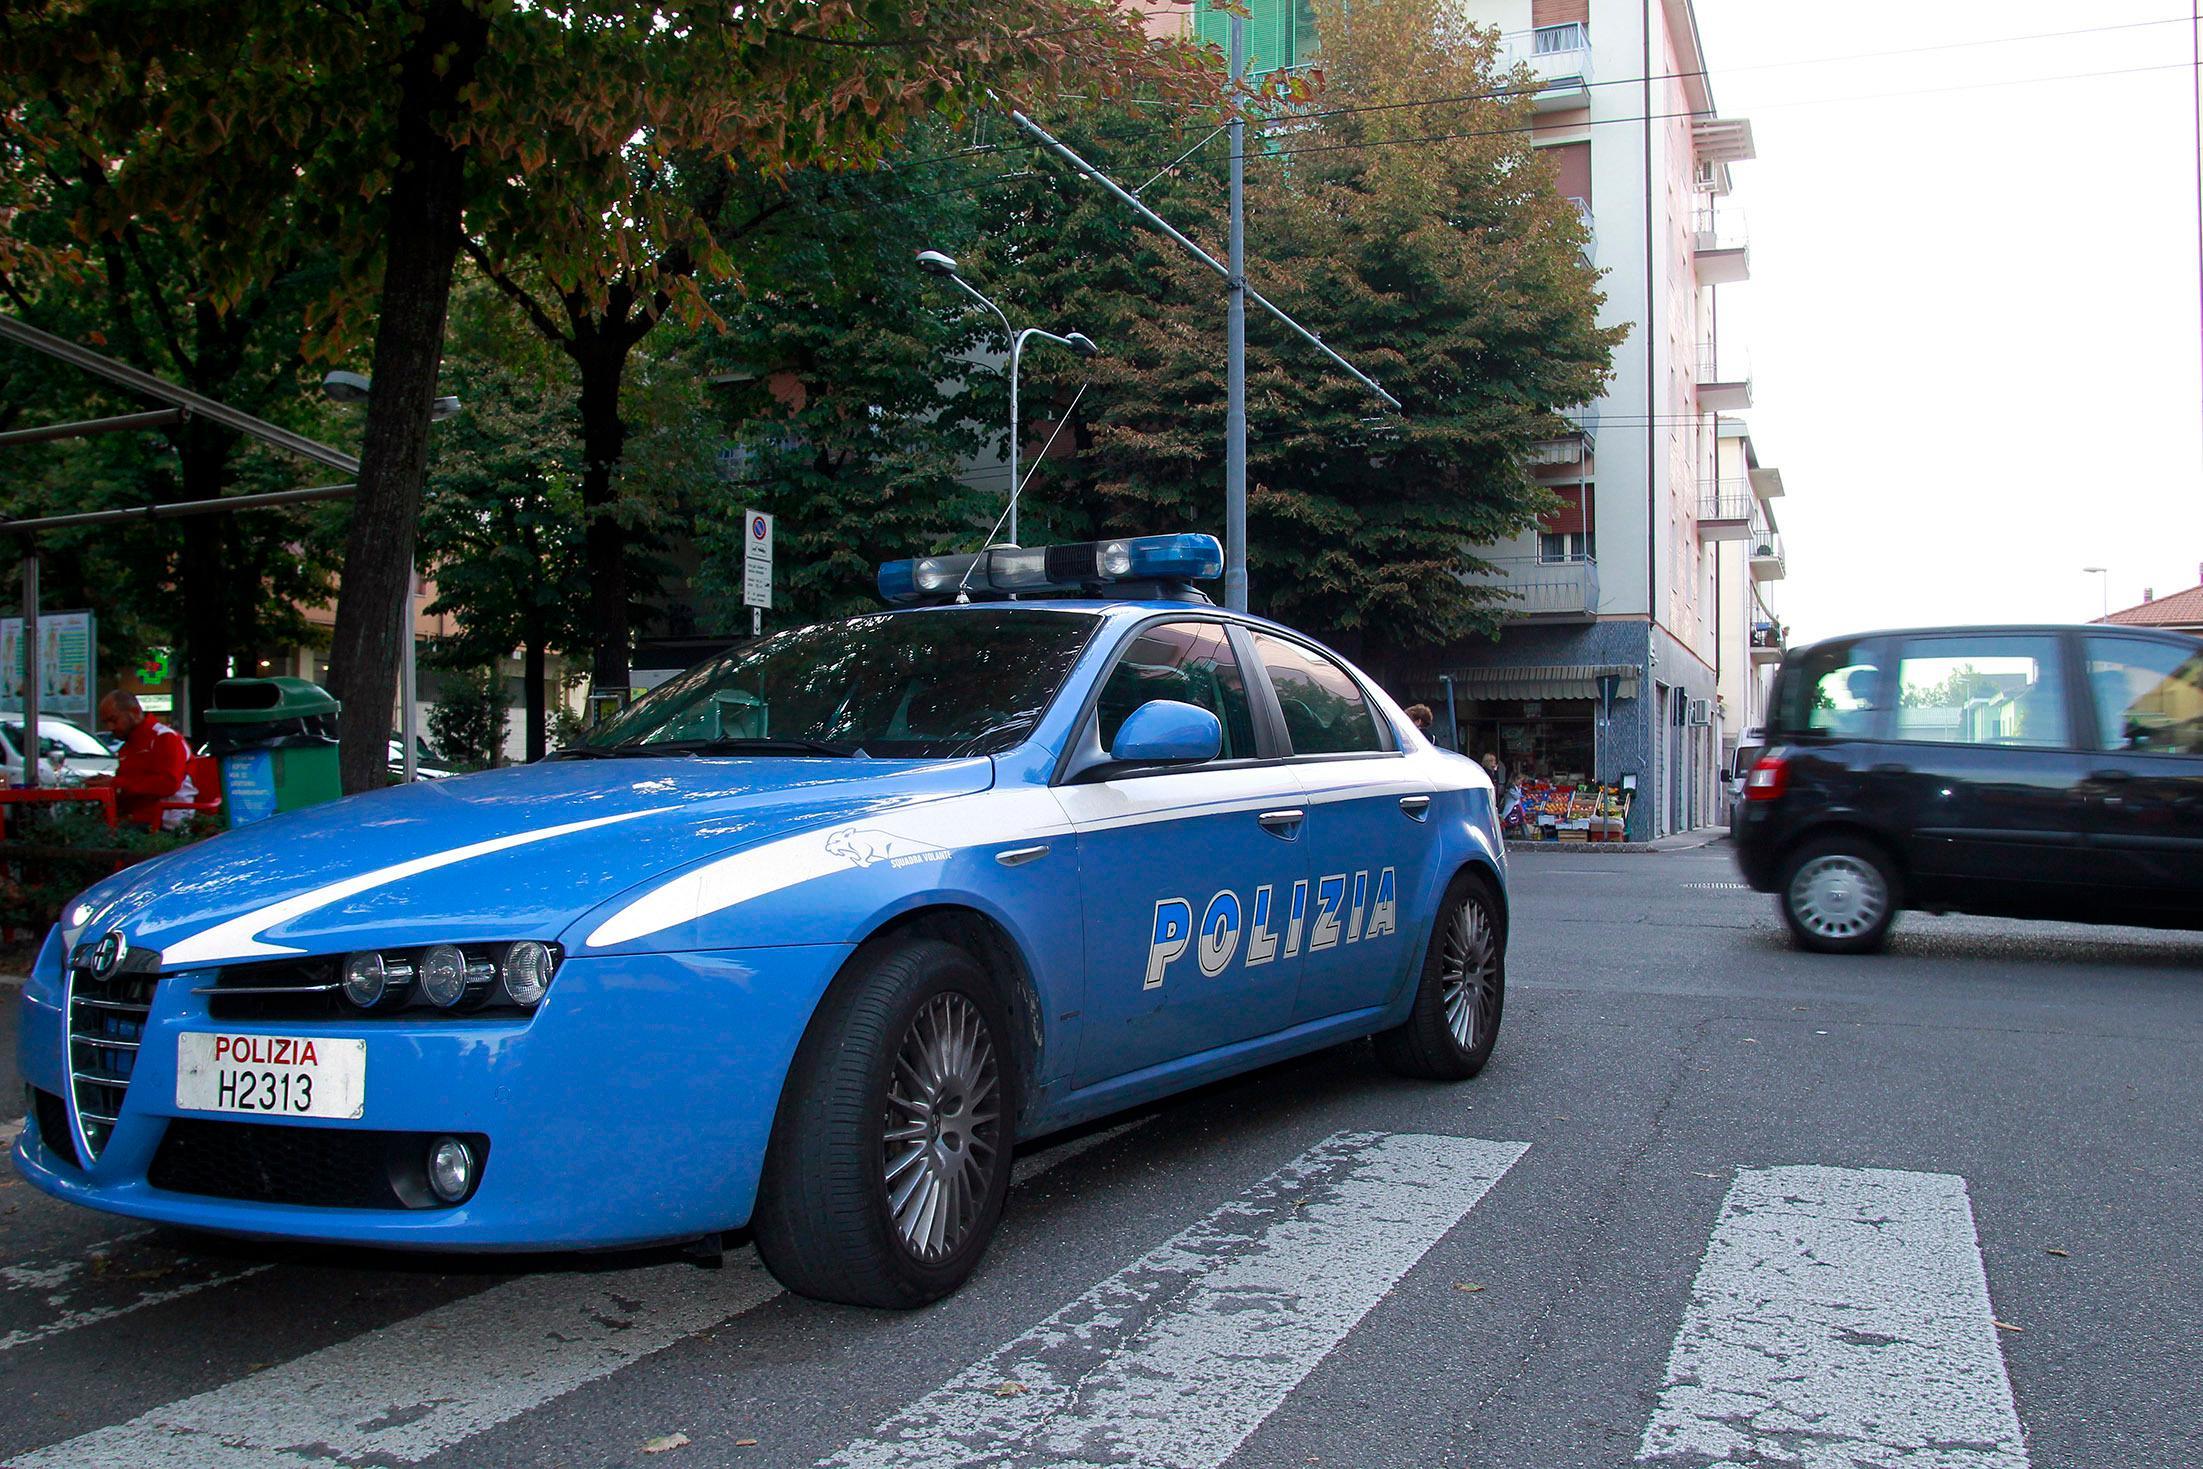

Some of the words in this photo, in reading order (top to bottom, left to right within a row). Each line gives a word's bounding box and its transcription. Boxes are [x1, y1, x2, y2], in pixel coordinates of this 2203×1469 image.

[890, 854, 923, 869] SQUADRA
[923, 850, 952, 862] VOLANTE
[1143, 866, 1395, 991] POLIZIA
[215, 1037, 318, 1066] POLIZIA
[218, 1070, 313, 1112] H2313
